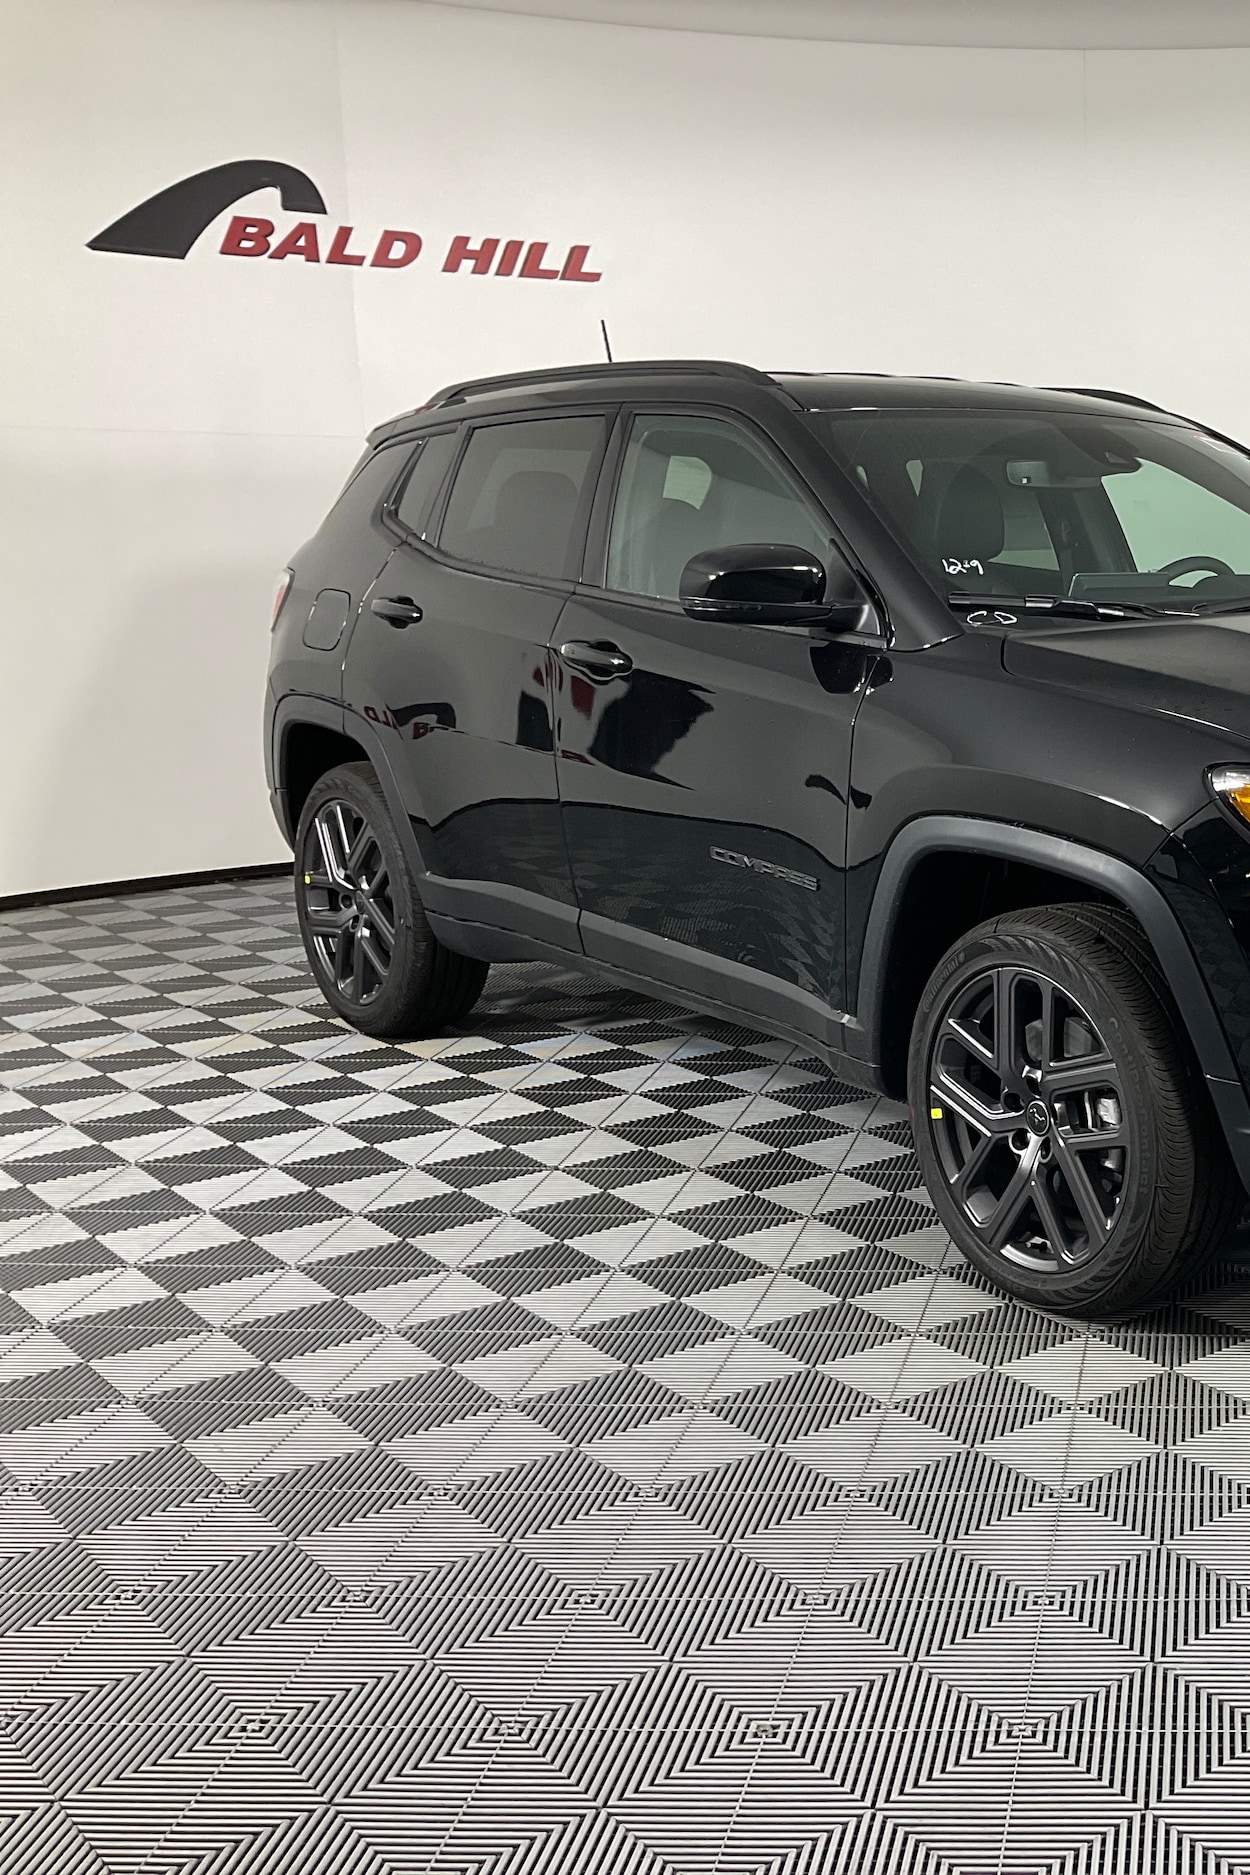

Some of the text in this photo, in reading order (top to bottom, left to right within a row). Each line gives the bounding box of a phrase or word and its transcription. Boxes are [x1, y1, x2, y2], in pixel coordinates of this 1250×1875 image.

[219, 215, 602, 282] BALD HILL
[709, 845, 819, 891] COMPASS
